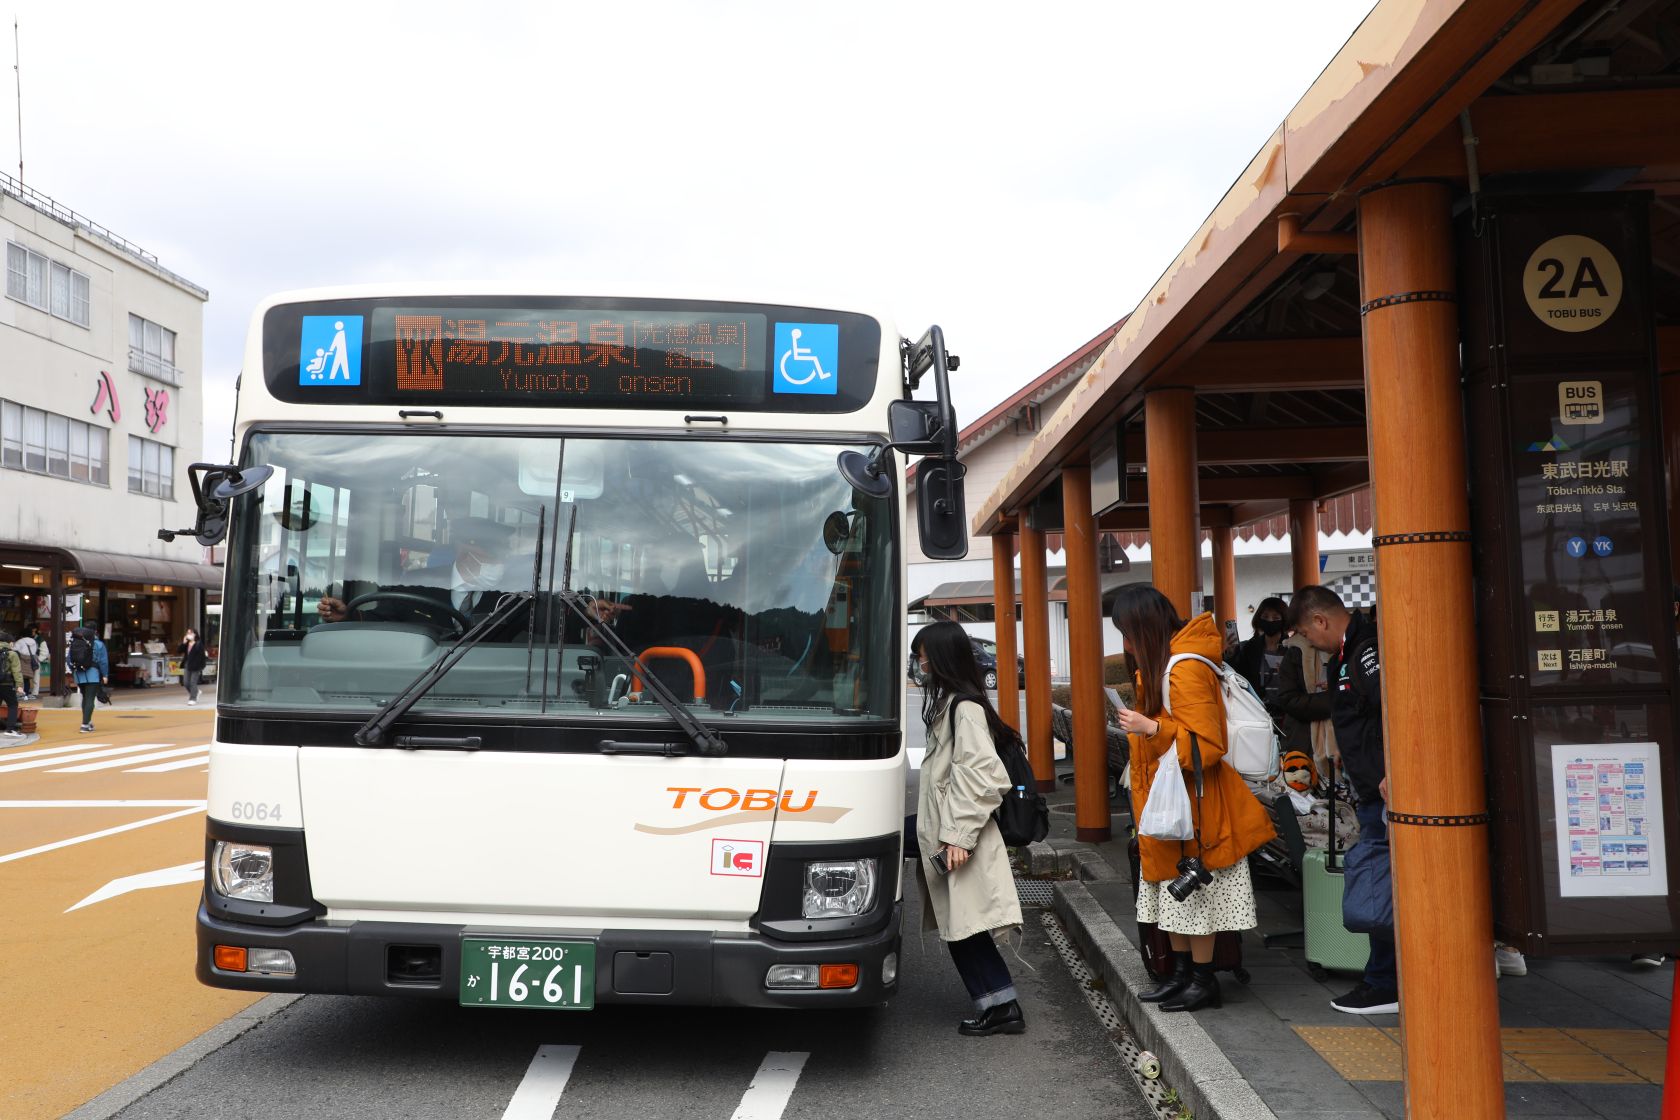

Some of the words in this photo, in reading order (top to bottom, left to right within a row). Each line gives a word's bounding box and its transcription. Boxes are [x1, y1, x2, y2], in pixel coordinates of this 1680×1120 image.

[1538, 257, 1609, 299] 2A
[1547, 309, 1577, 319] TOBU
[1579, 308, 1602, 318] BUS
[444, 319, 631, 368] 湯元温泉
[401, 327, 439, 375] YK
[664, 346, 715, 369] 経由
[500, 367, 589, 392] Yumoto
[618, 375, 693, 393] onsen
[1565, 386, 1597, 399] BUS
[1541, 460, 1629, 480] 東武日光駅
[1605, 484, 1626, 495] Sta.
[1536, 503, 1582, 514] 东武日光站
[1571, 541, 1581, 553] Y
[1595, 541, 1611, 551] YK
[1538, 613, 1556, 622] 行先
[1566, 609, 1618, 623] 湯元温泉
[1566, 623, 1595, 631] Yumoto
[1601, 622, 1624, 630] onsen
[1541, 652, 1558, 661] 次は
[1568, 648, 1607, 662] 石屋町
[1569, 661, 1618, 671] Ishiya-machi
[666, 787, 819, 813] TOBU
[231, 801, 282, 821] 6064
[466, 974, 481, 988] か
[490, 962, 582, 1004] 16-61
